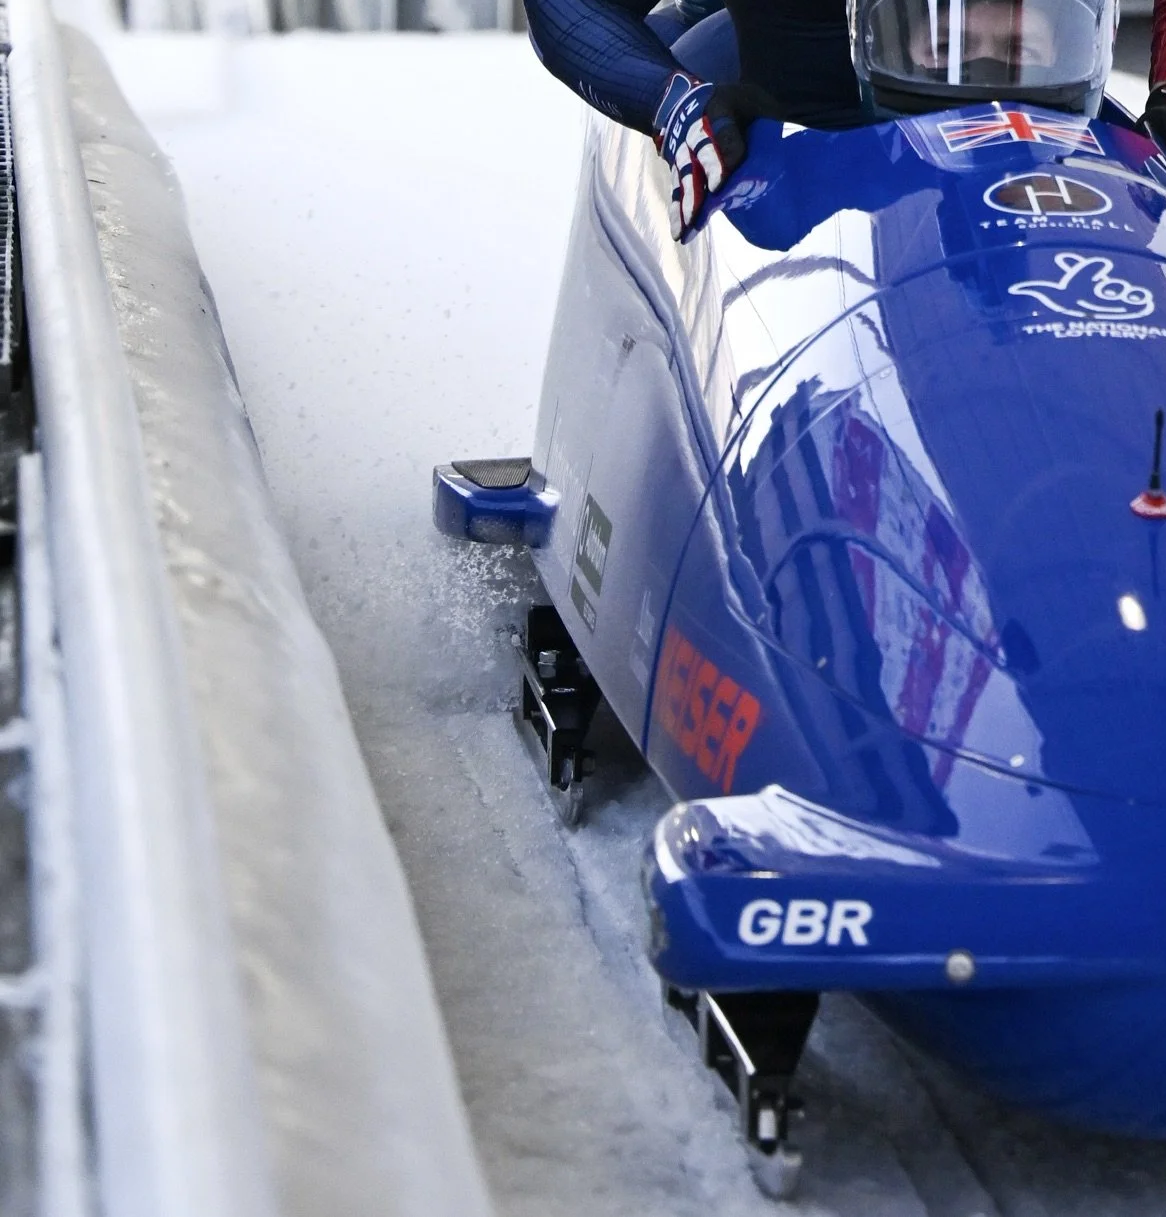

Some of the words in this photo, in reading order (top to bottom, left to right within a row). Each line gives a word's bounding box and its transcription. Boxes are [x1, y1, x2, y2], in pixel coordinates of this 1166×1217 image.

[979, 216, 1048, 230] TEAM
[1071, 216, 1135, 232] HALL
[1022, 322, 1066, 334] THE
[1054, 329, 1147, 340] LOTTERY
[738, 898, 873, 946] GBR
